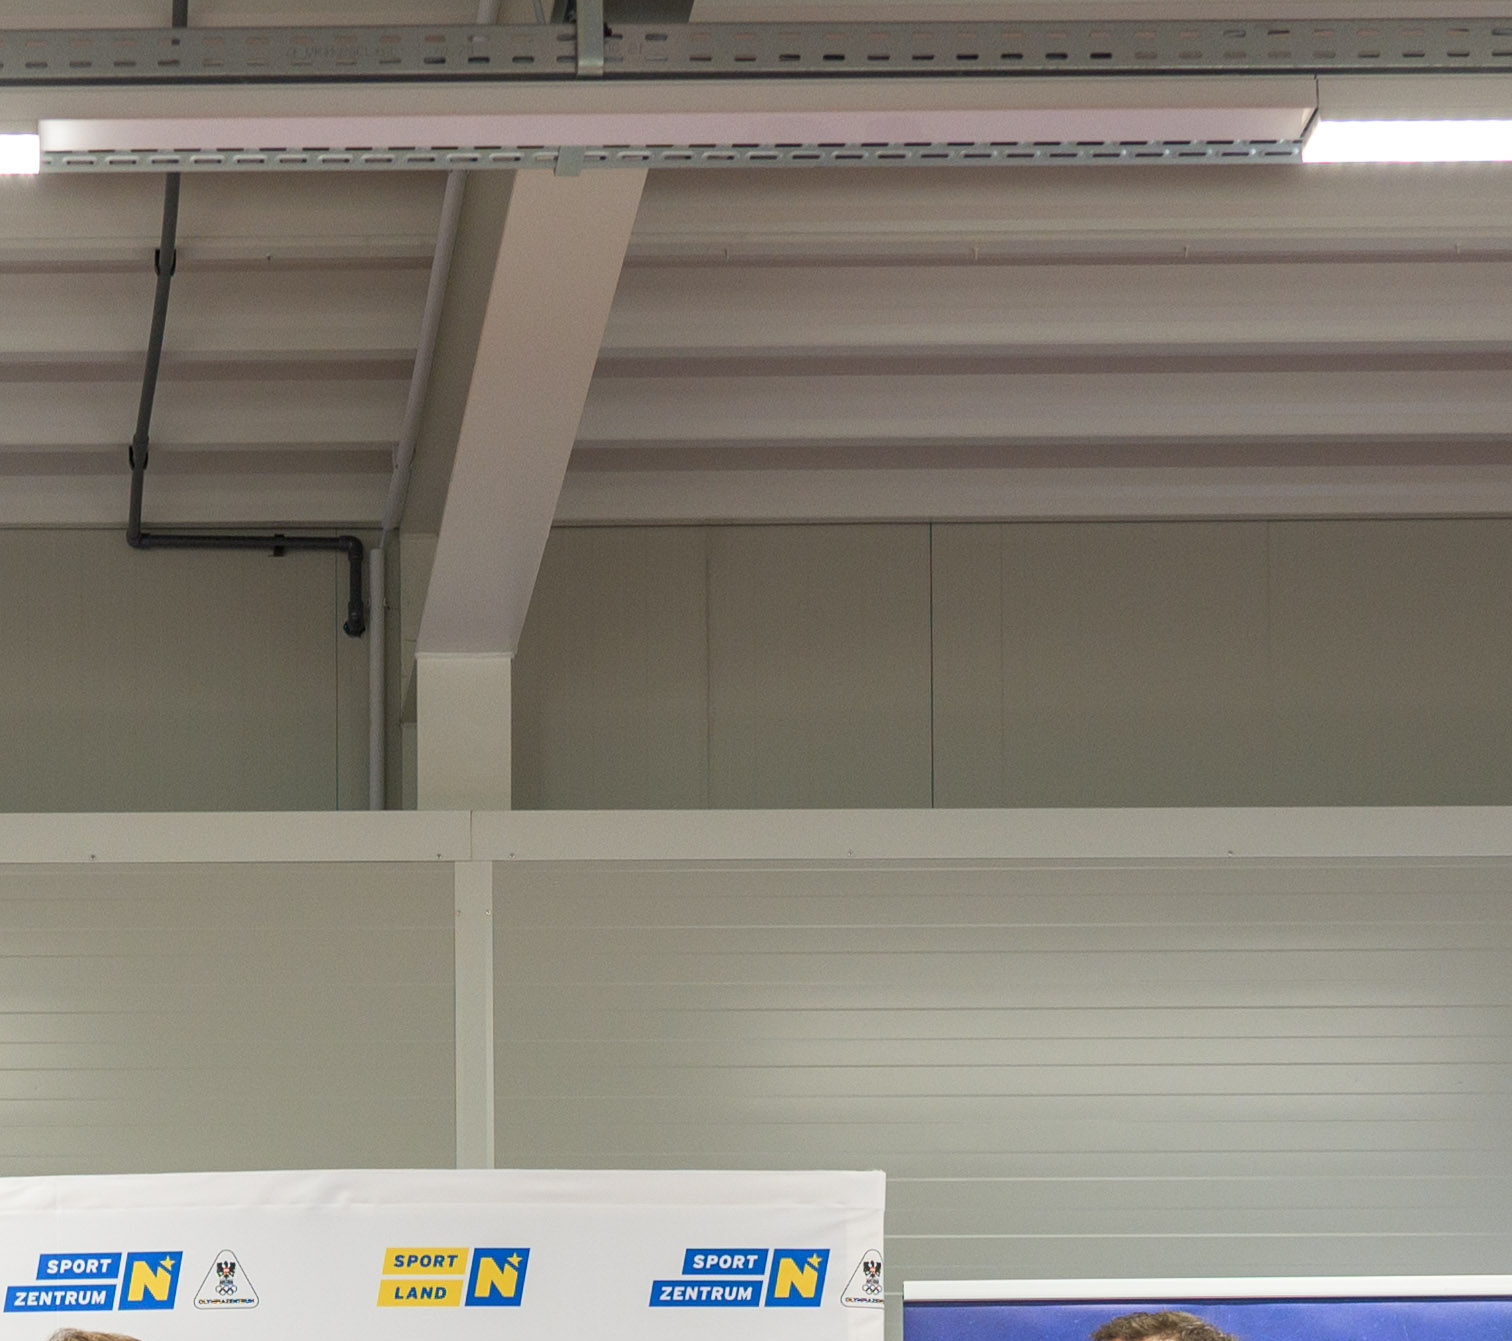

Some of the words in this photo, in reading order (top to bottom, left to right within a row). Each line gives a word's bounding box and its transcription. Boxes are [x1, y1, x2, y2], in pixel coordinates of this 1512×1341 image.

[46, 1258, 113, 1275] SPORT
[393, 1254, 459, 1268] SPORT
[692, 1254, 759, 1270] SPORT
[13, 1290, 107, 1307] ZENTRUM
[394, 1286, 447, 1300] LAND
[659, 1285, 753, 1301] ZENTRUM
